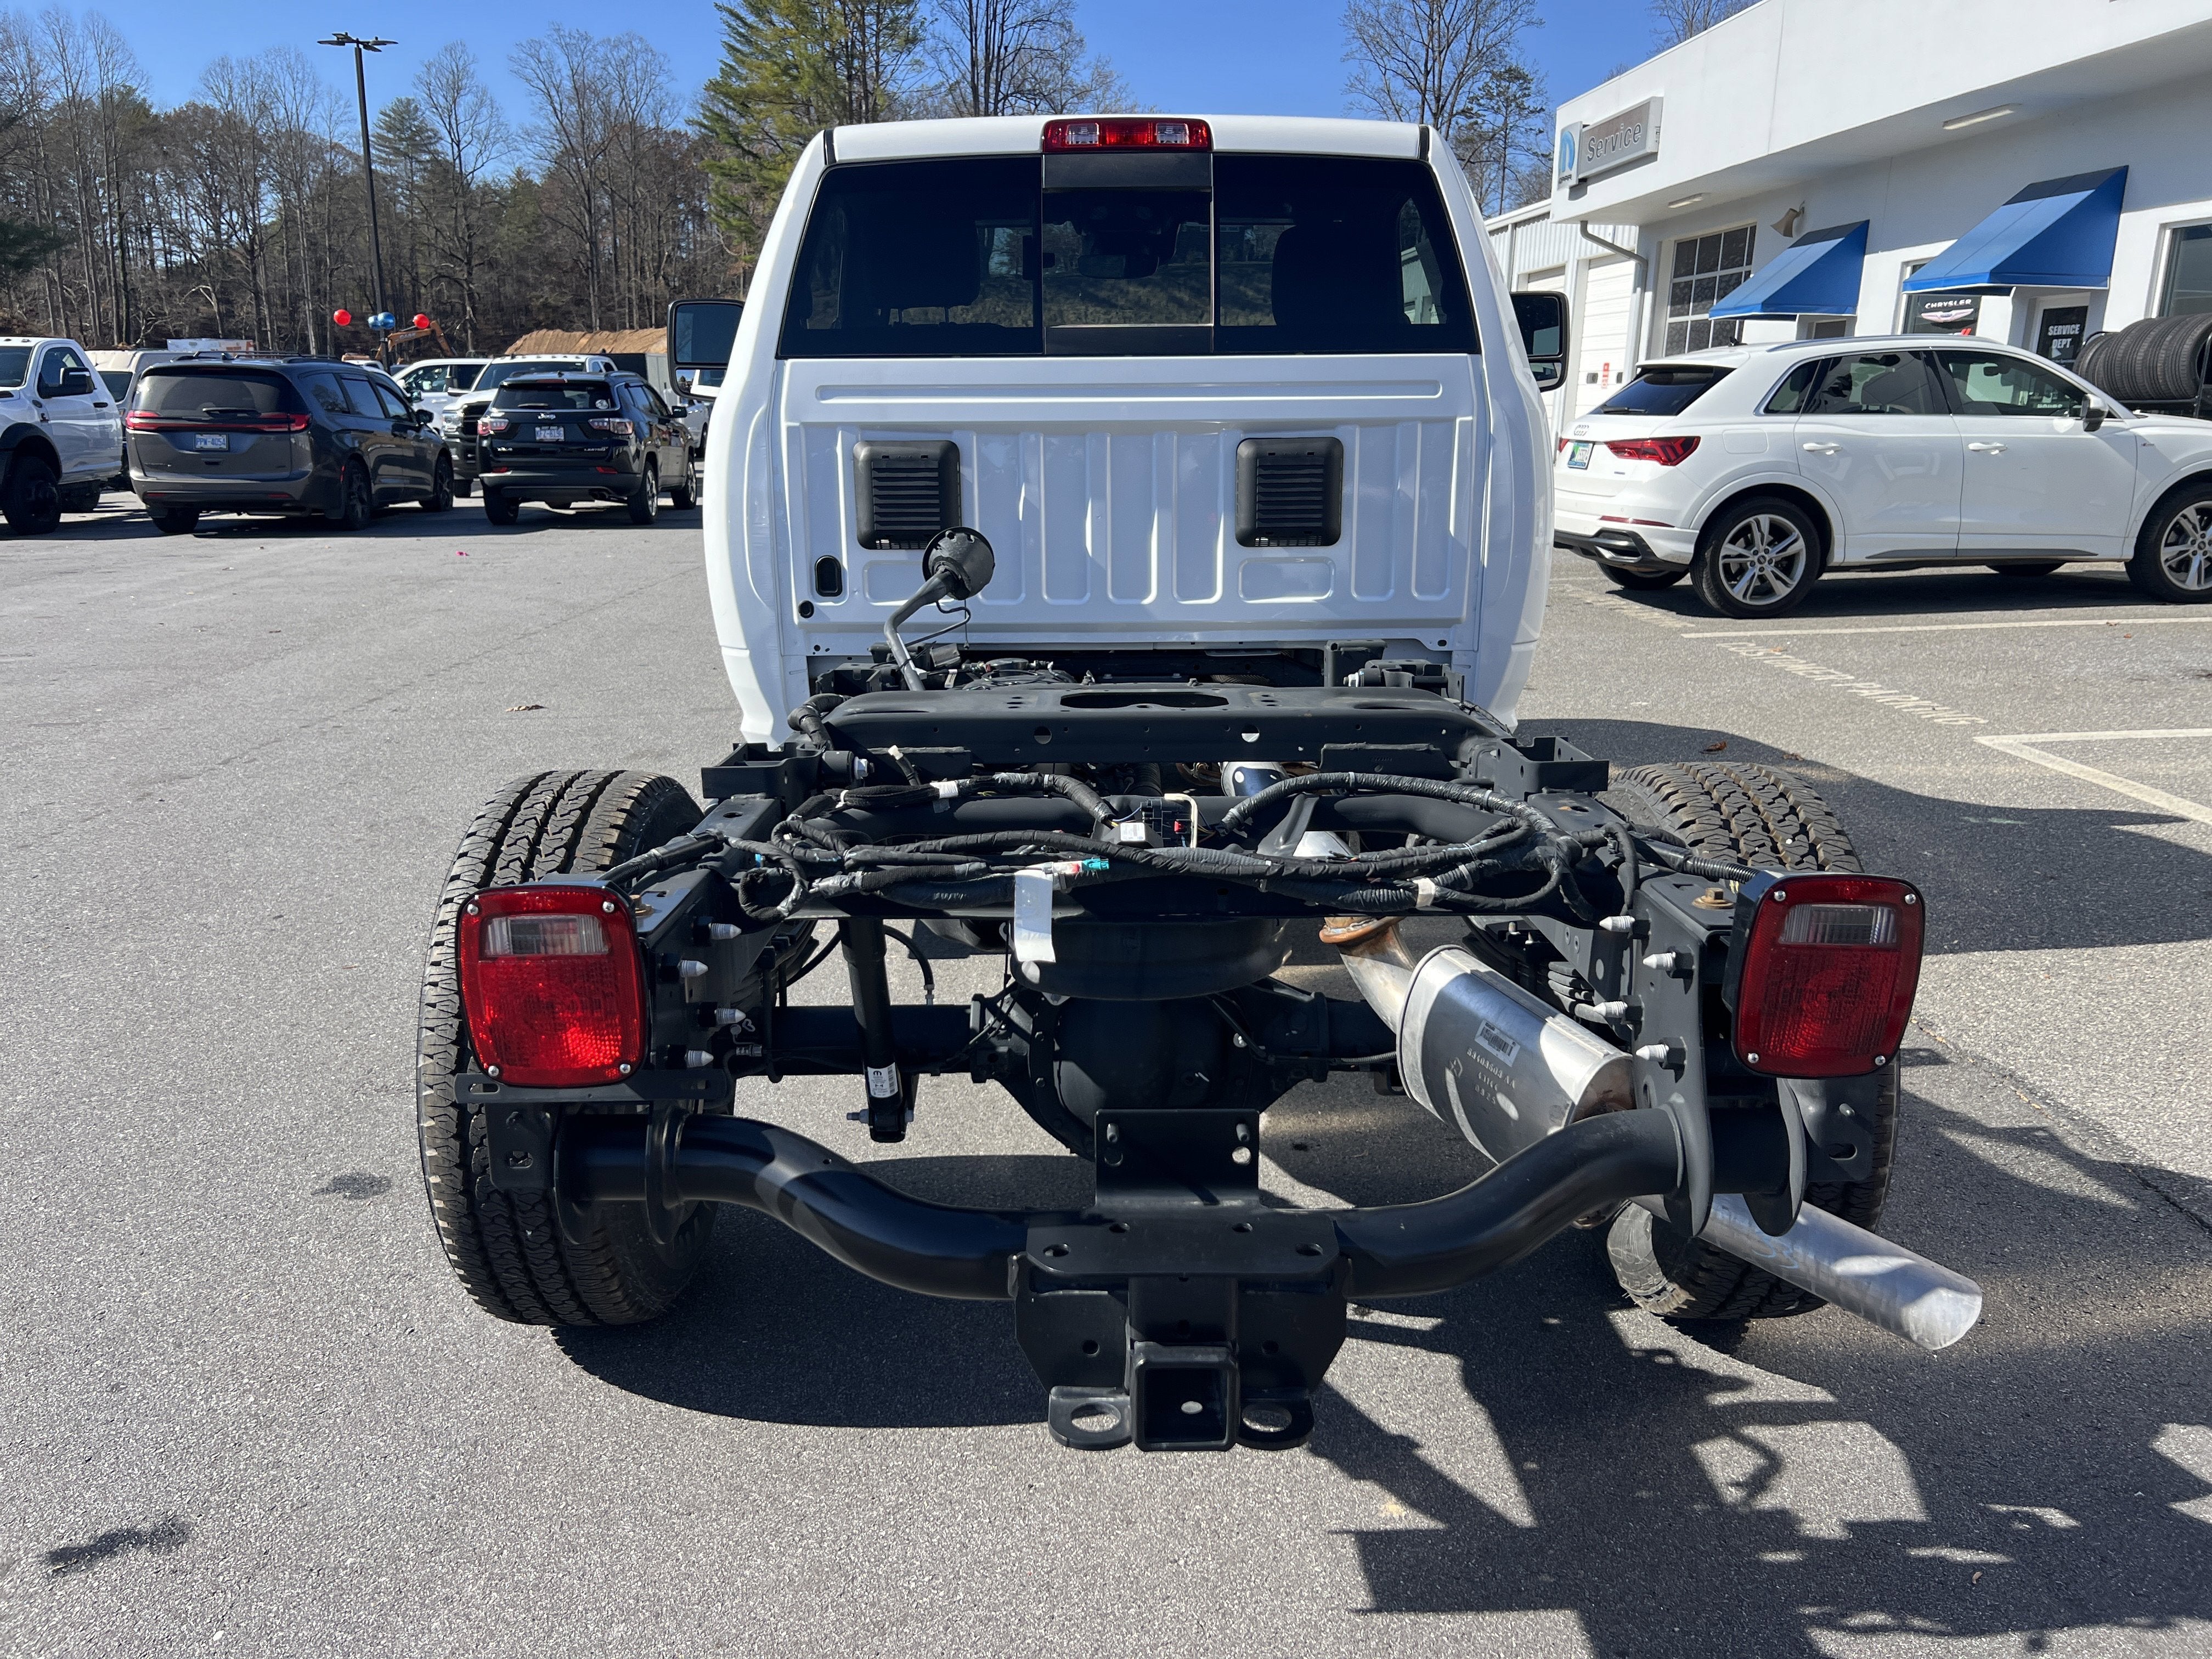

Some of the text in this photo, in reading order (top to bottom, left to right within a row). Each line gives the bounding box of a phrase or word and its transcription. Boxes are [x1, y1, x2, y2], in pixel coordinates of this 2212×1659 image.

[1587, 122, 1642, 162] Service
[1925, 298, 1972, 309] CHRYSLER
[2047, 324, 2081, 336] SERVICE
[2052, 337, 2073, 348] DEPT
